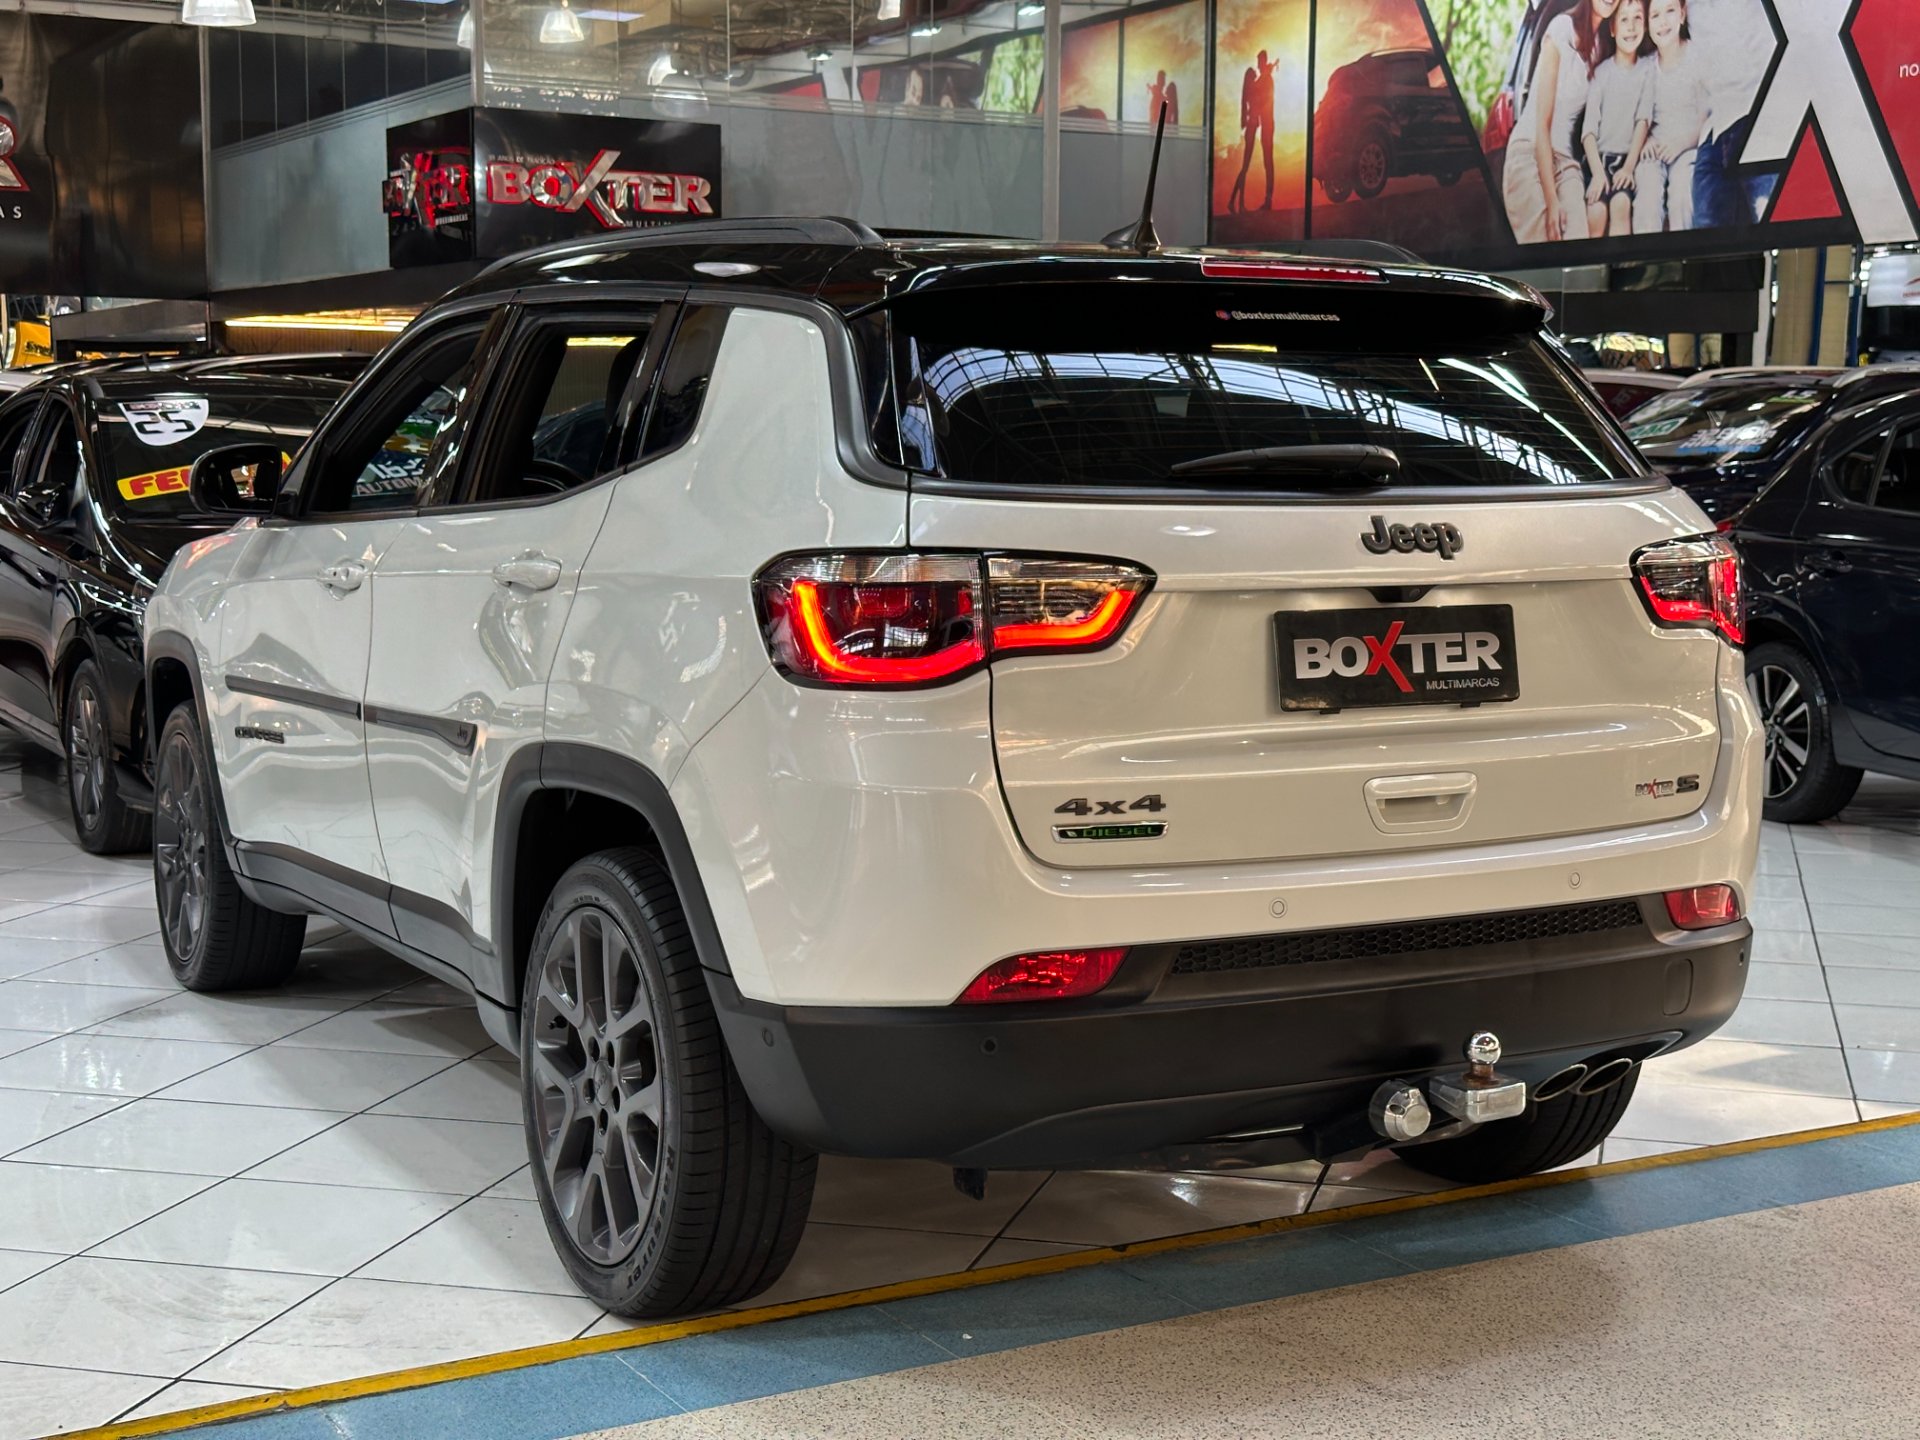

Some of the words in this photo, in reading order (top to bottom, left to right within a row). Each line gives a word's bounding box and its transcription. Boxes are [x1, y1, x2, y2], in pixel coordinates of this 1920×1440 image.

[486, 148, 714, 228] BOXTER
[1231, 309, 1340, 321] @boxtermultimarcas
[131, 411, 197, 435] 25
[1359, 515, 1464, 561] Jeep
[1293, 621, 1503, 693] BOXTER
[1426, 677, 1501, 691] MULTIMARCAS
[1054, 794, 1166, 816] 4x4
[1083, 826, 1160, 839] DIESEL
